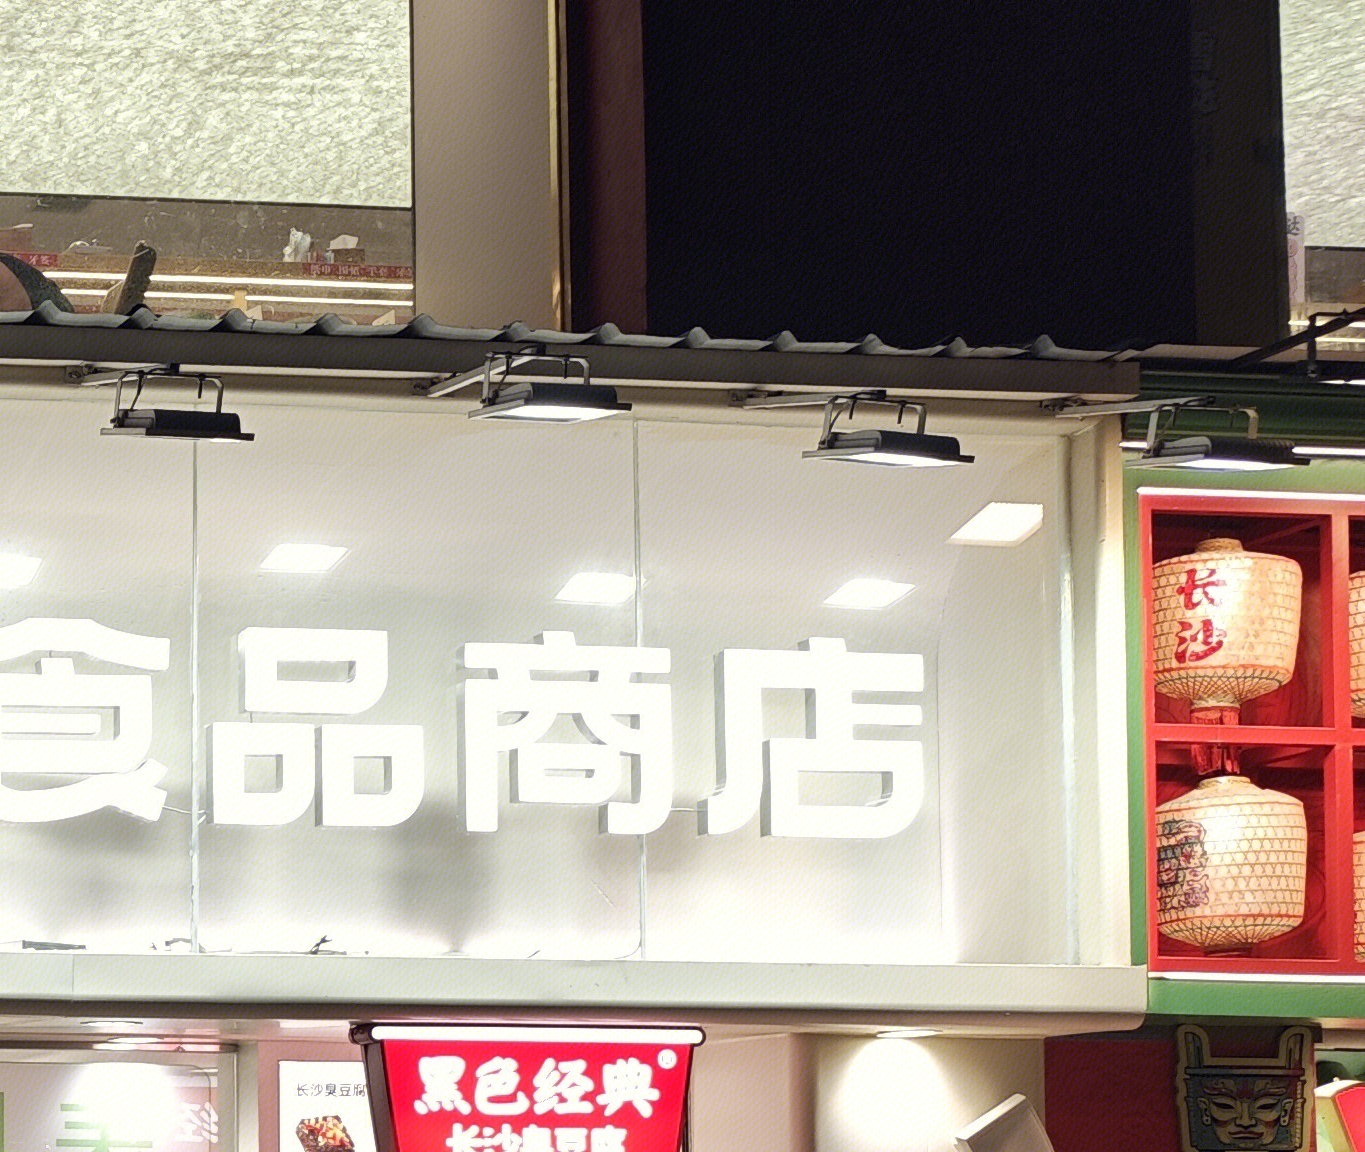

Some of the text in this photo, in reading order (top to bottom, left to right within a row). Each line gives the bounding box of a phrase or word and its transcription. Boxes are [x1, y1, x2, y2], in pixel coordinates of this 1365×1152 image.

[1172, 567, 1228, 666] 长沙
[413, 1055, 661, 1118] 黑色经典
